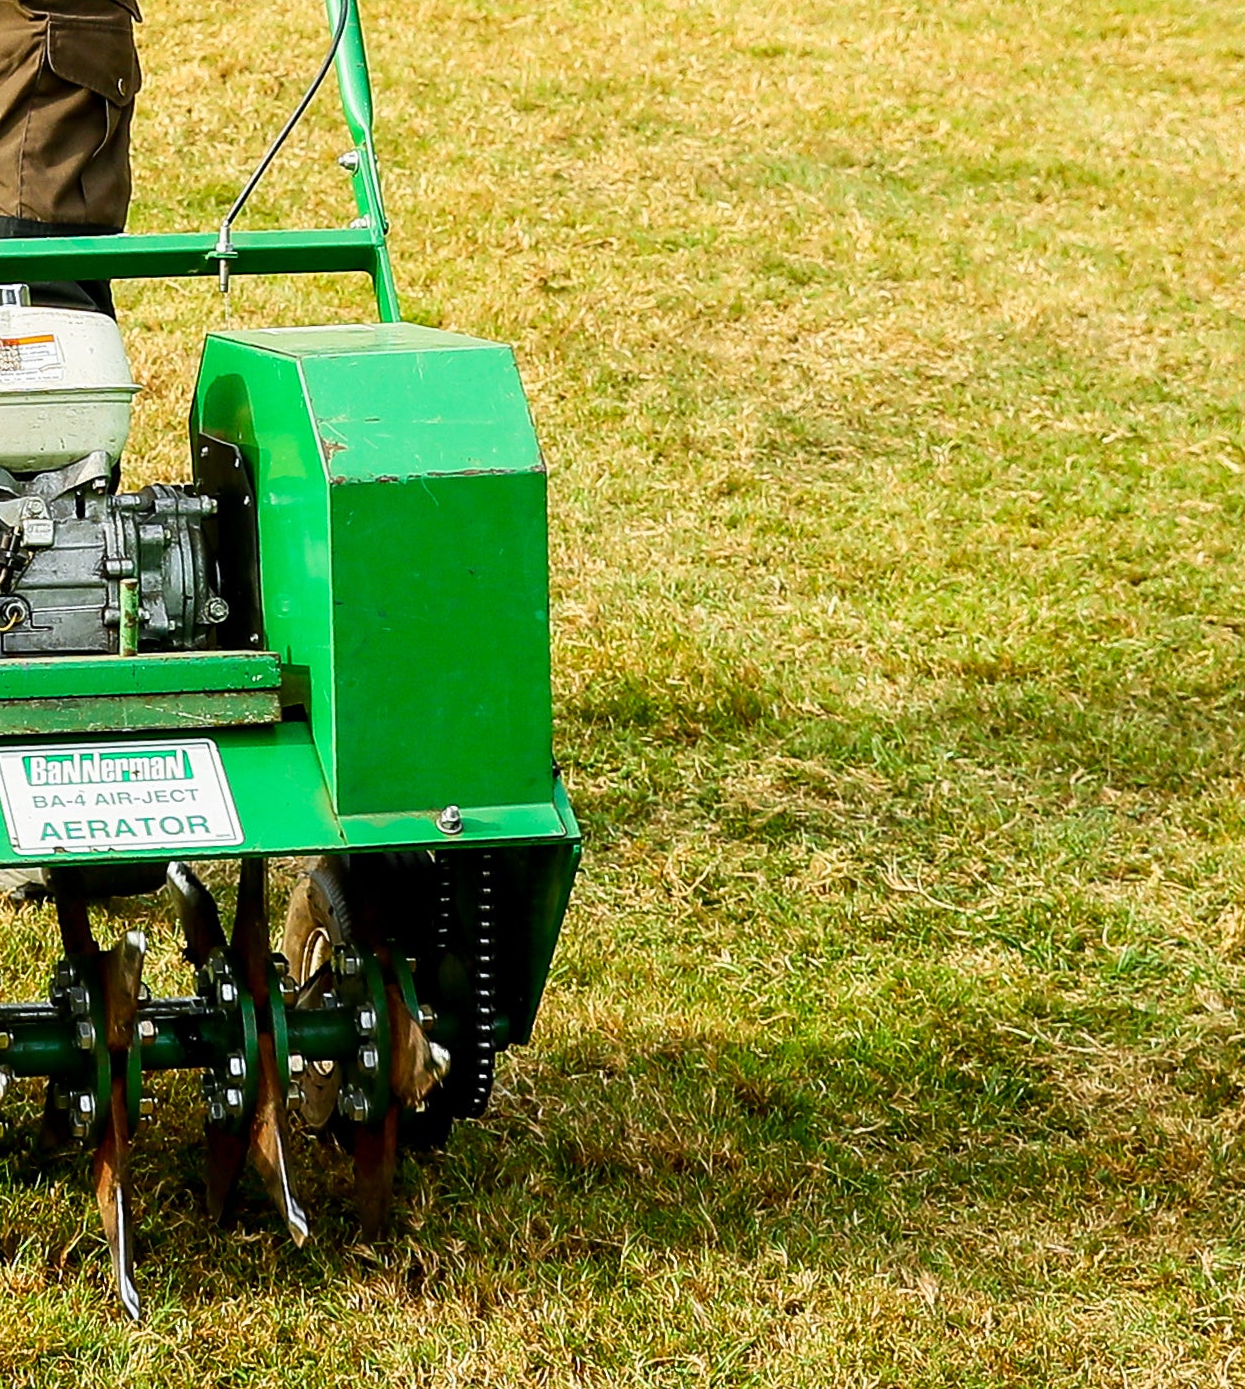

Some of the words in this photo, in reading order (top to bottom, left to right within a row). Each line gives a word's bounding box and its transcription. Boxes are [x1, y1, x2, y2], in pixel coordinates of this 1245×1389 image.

[32, 792, 87, 809] BA-4
[95, 788, 199, 806] AIR-JECT
[39, 814, 211, 841] AERATOR
